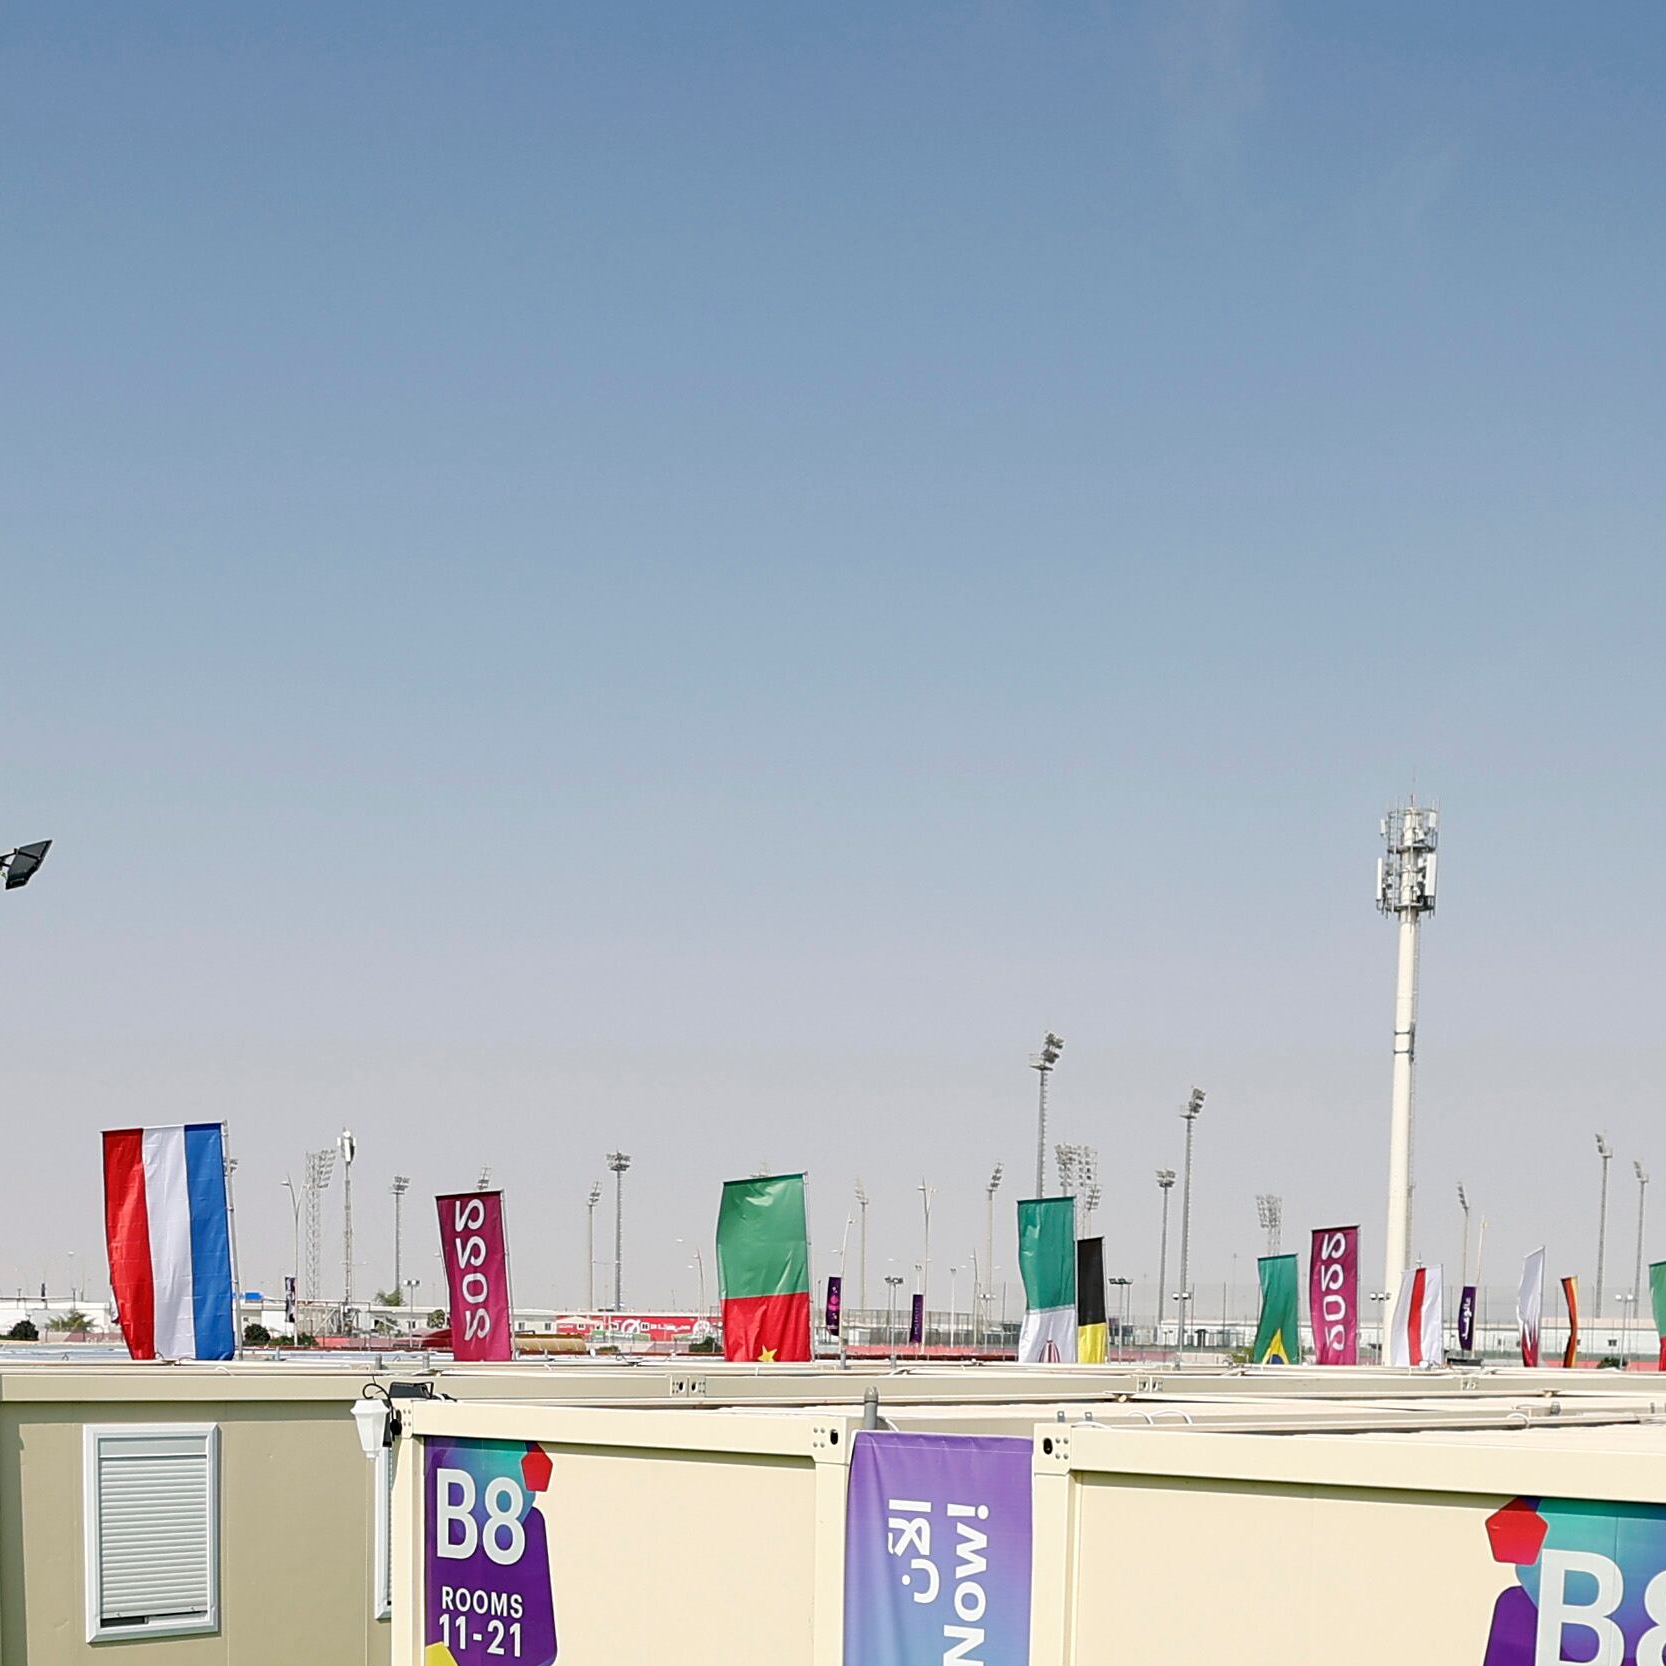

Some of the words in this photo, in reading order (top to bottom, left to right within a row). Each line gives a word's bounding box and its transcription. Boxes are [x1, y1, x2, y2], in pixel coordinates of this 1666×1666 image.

[436, 1468, 526, 1566] B8
[888, 1499, 940, 1604] الآن
[438, 1613, 521, 1658] 11-21
[441, 1586, 523, 1619] ROOMS
